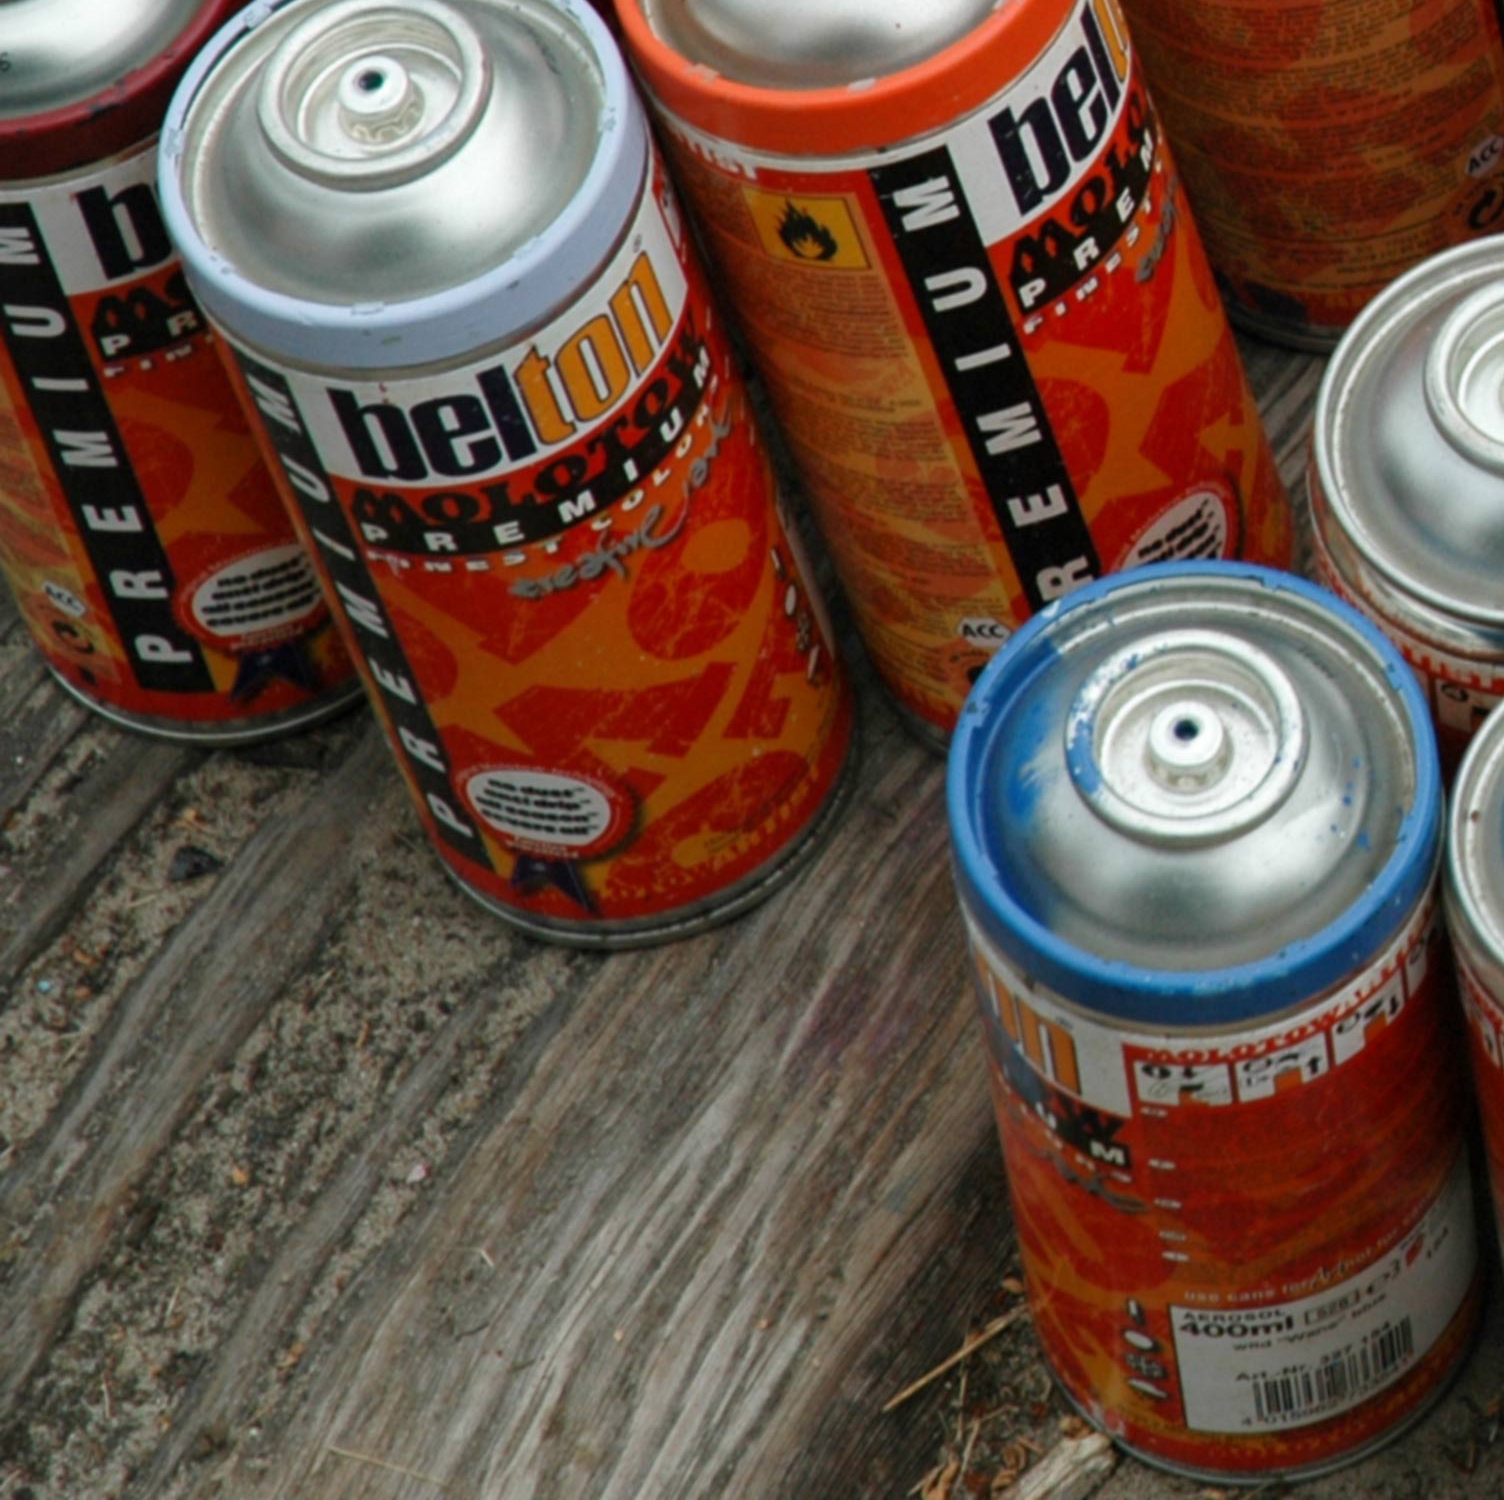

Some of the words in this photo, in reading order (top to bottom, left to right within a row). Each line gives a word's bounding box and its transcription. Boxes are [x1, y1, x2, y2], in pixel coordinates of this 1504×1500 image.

[326, 252, 675, 481] belton
[1180, 1315, 1294, 1338] 400ml
[1183, 1308, 1284, 1323] AEROSOL
